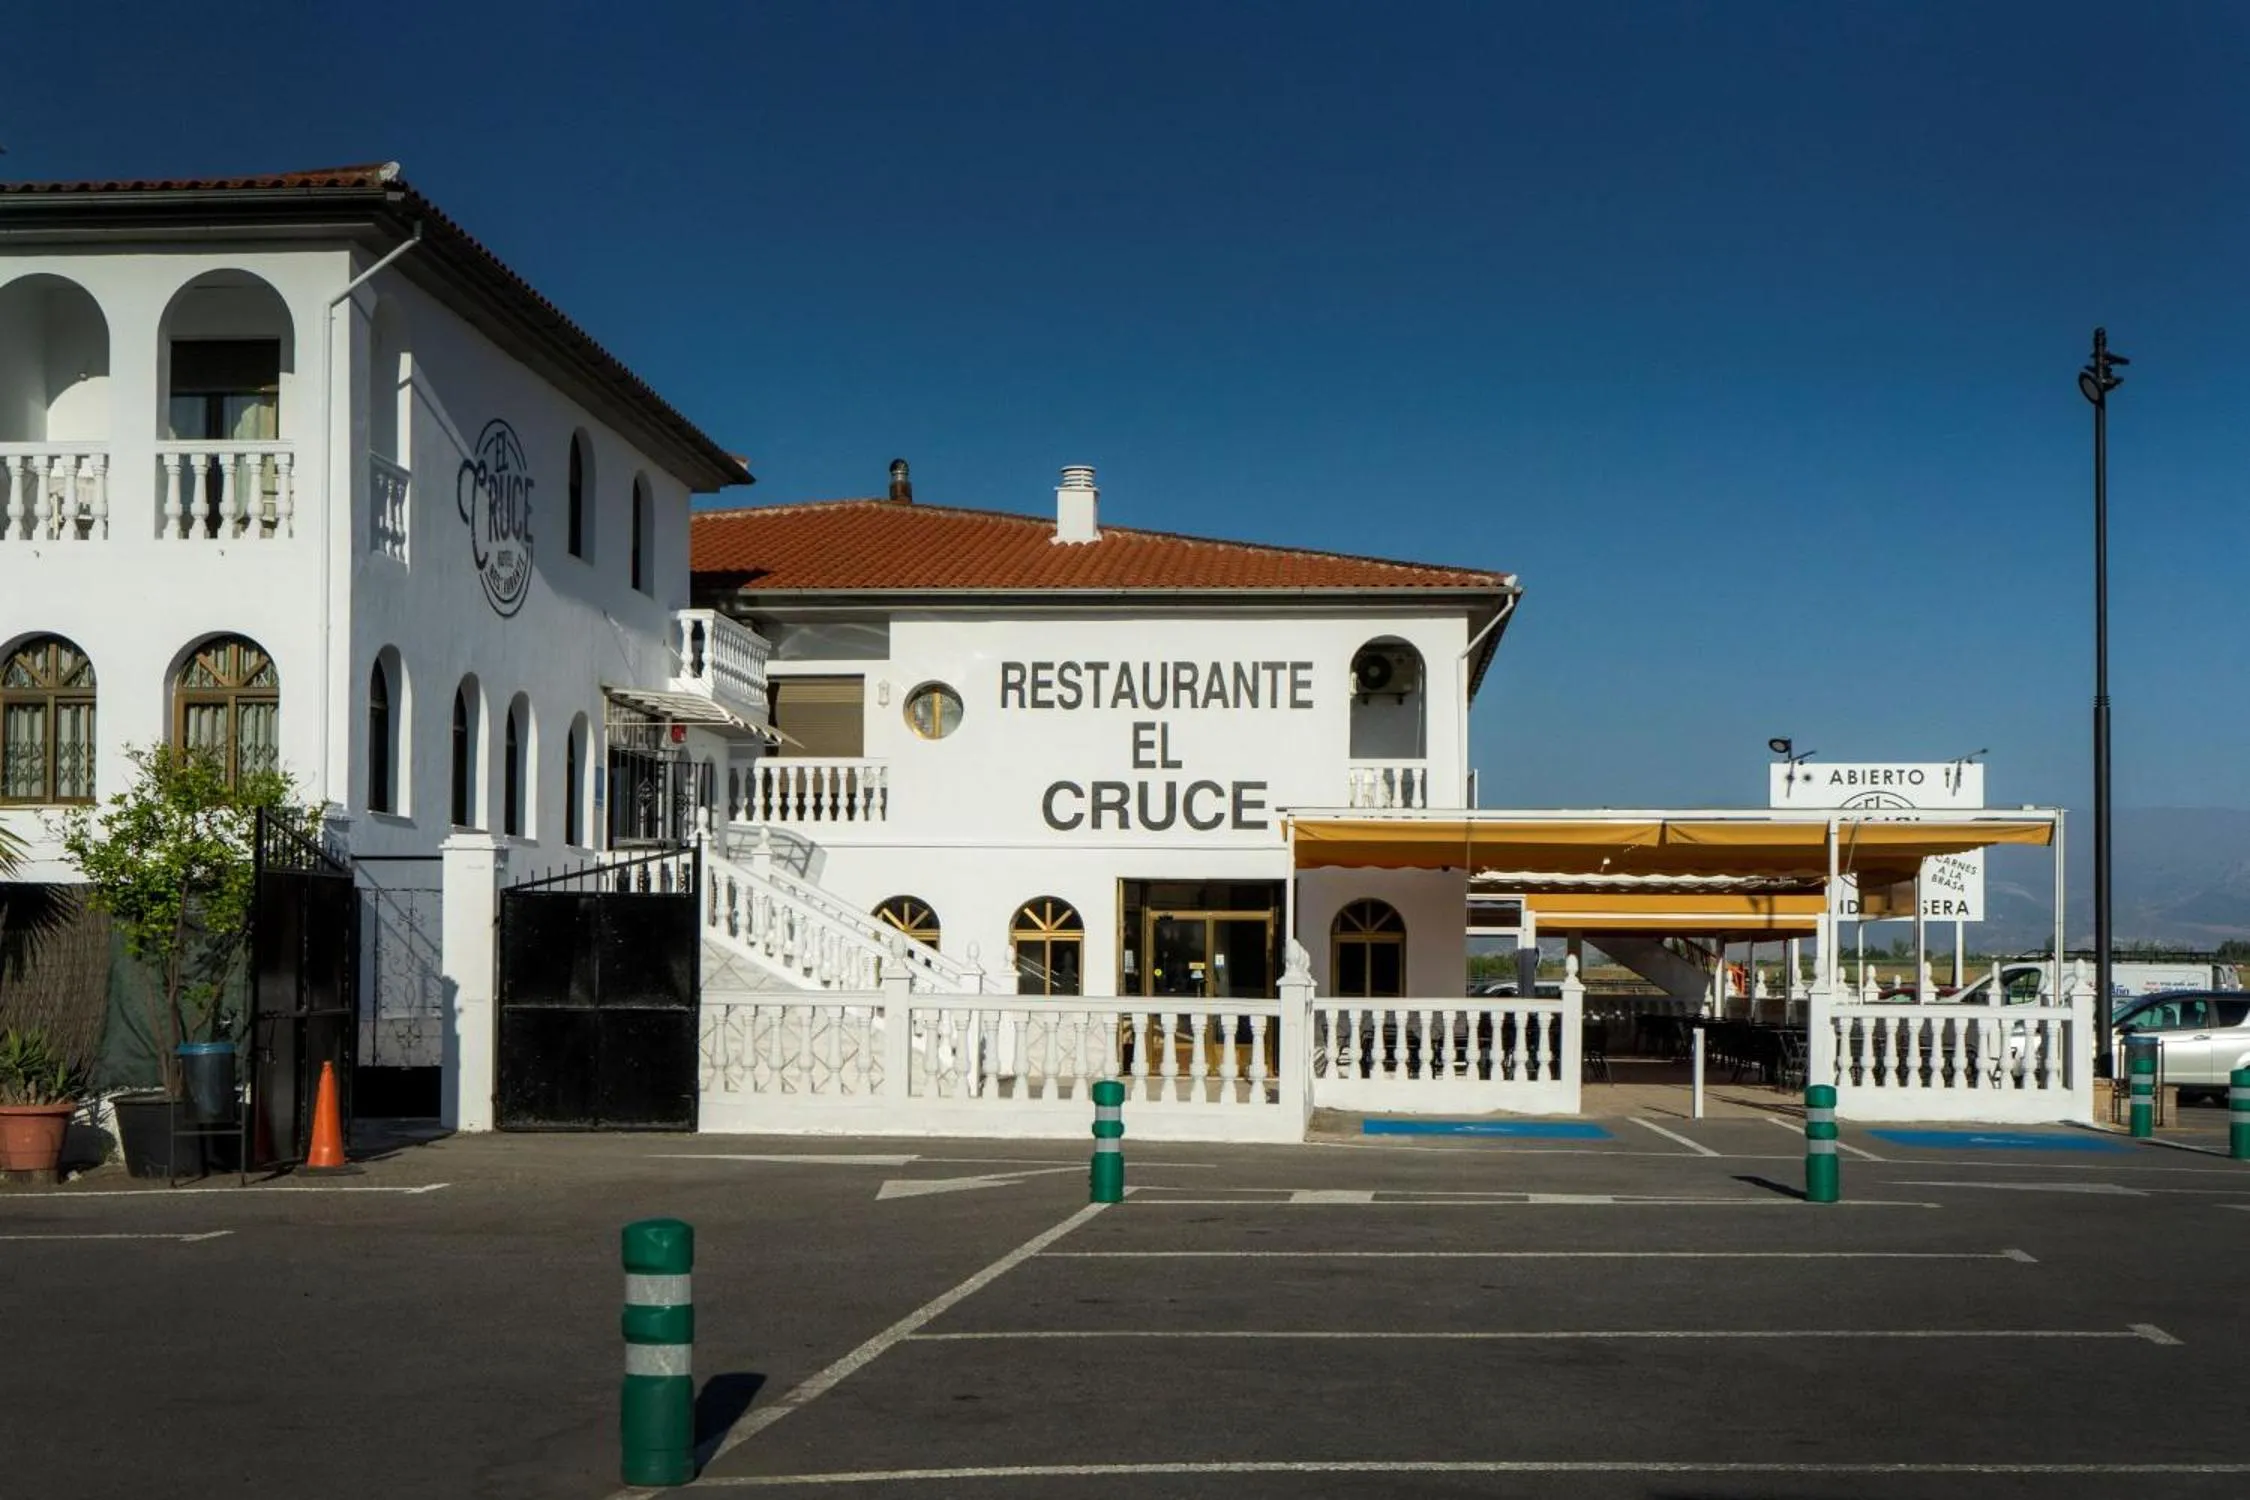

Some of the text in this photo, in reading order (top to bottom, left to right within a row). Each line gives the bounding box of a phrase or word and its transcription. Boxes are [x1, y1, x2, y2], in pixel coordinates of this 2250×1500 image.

[457, 458, 535, 570] CRUCE
[1001, 661, 1314, 709] RESTAURANTE
[1132, 721, 1183, 769] EL
[1829, 769, 1925, 785] ABIERTO
[1042, 779, 1268, 831] CRUCE
[1931, 873, 1965, 892] BRASA
[1938, 866, 1962, 881] A LA
